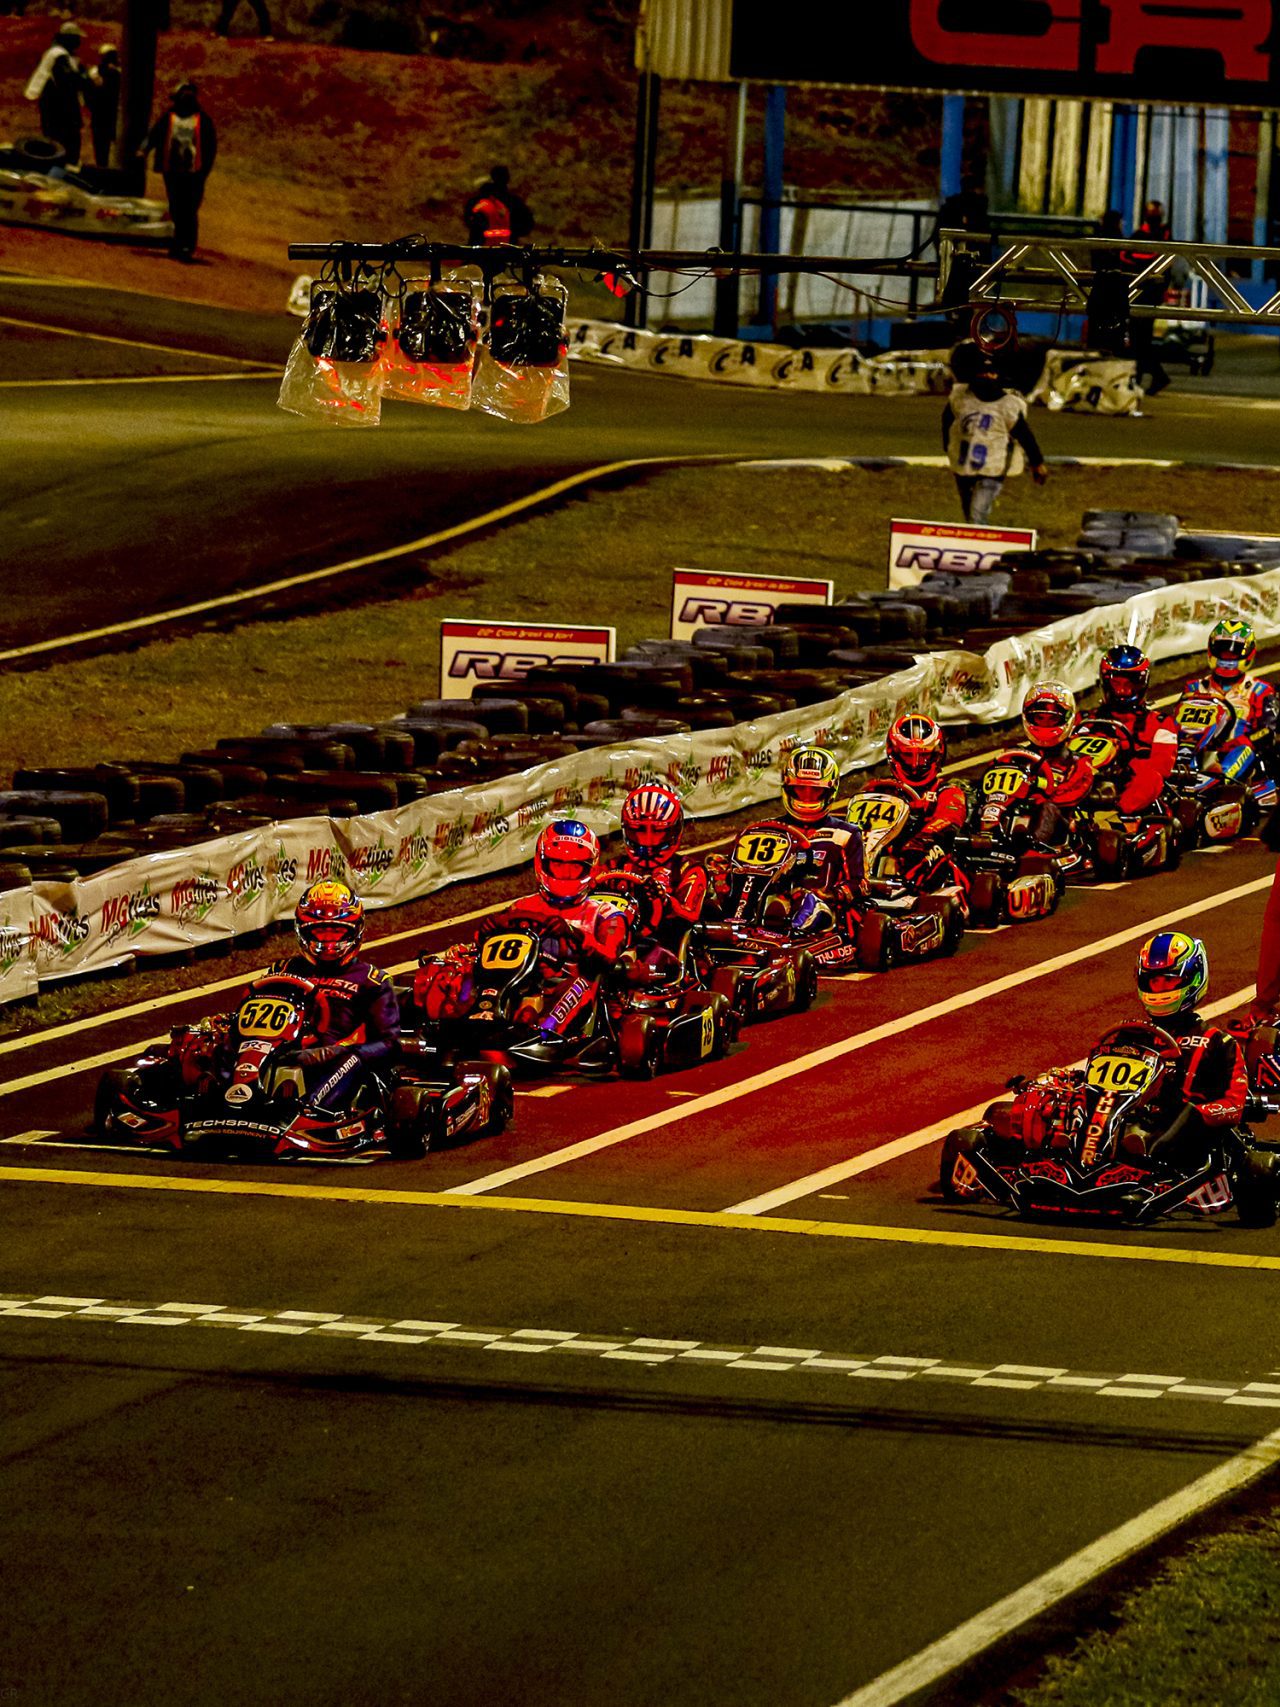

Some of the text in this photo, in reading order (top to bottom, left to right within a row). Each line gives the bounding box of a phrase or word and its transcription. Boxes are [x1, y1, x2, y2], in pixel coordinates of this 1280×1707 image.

[678, 598, 775, 627] RB
[448, 650, 600, 680] RB
[984, 772, 1019, 792] 311
[856, 801, 897, 823] 144
[747, 837, 778, 862] 13
[486, 939, 523, 963] 18
[240, 1002, 290, 1032] 526
[1095, 1061, 1149, 1088] 104
[184, 1118, 281, 1135] TECHSPEED
